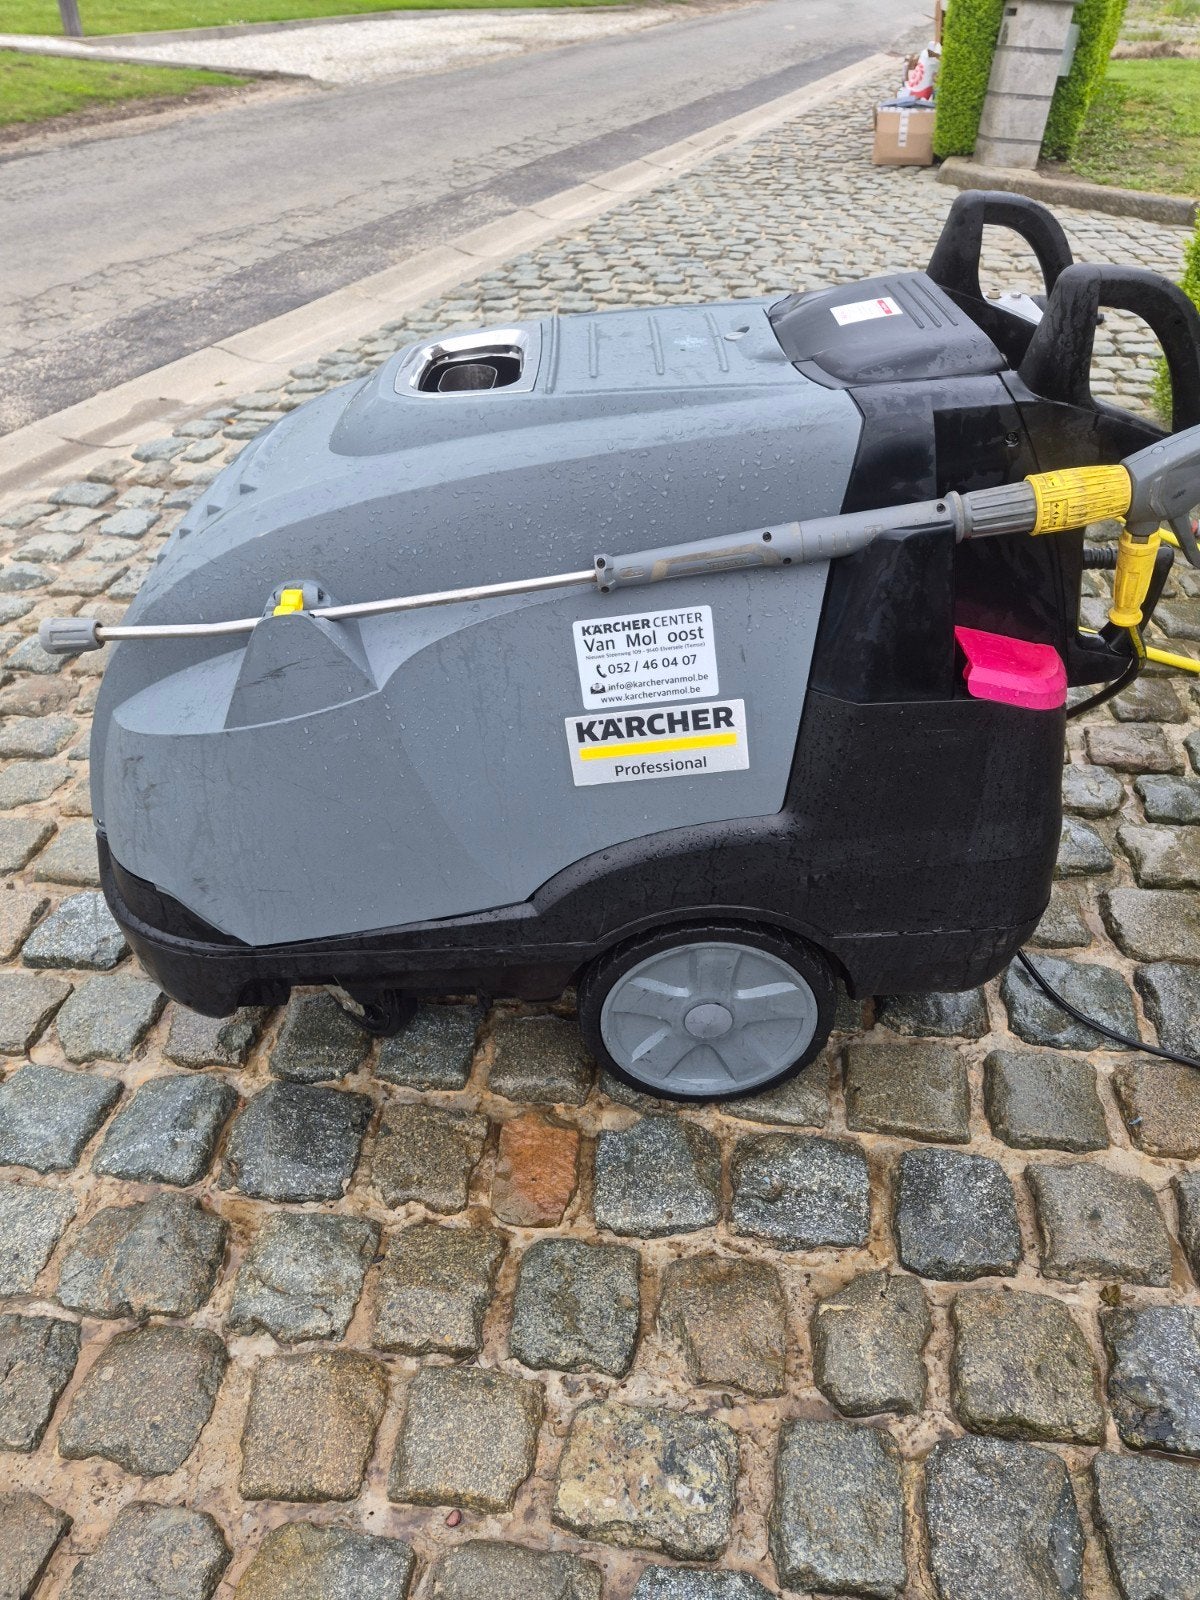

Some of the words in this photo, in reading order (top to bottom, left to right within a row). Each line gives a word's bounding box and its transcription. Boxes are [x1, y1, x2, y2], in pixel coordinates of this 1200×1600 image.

[581, 618, 651, 637] KÄRCHER
[653, 612, 703, 628] CENTER
[583, 638, 616, 653] Van
[626, 630, 657, 648] Mol
[667, 626, 704, 643] oost
[607, 662, 631, 675] 052
[633, 660, 639, 673] /
[642, 658, 659, 671] 46
[661, 656, 679, 668] 04
[682, 654, 697, 666] 07
[607, 673, 709, 692] info@karchervanmol.be
[600, 685, 701, 704] www.karchervanmol.be
[575, 706, 735, 743] KÄRCHER
[615, 756, 707, 777] Professional
